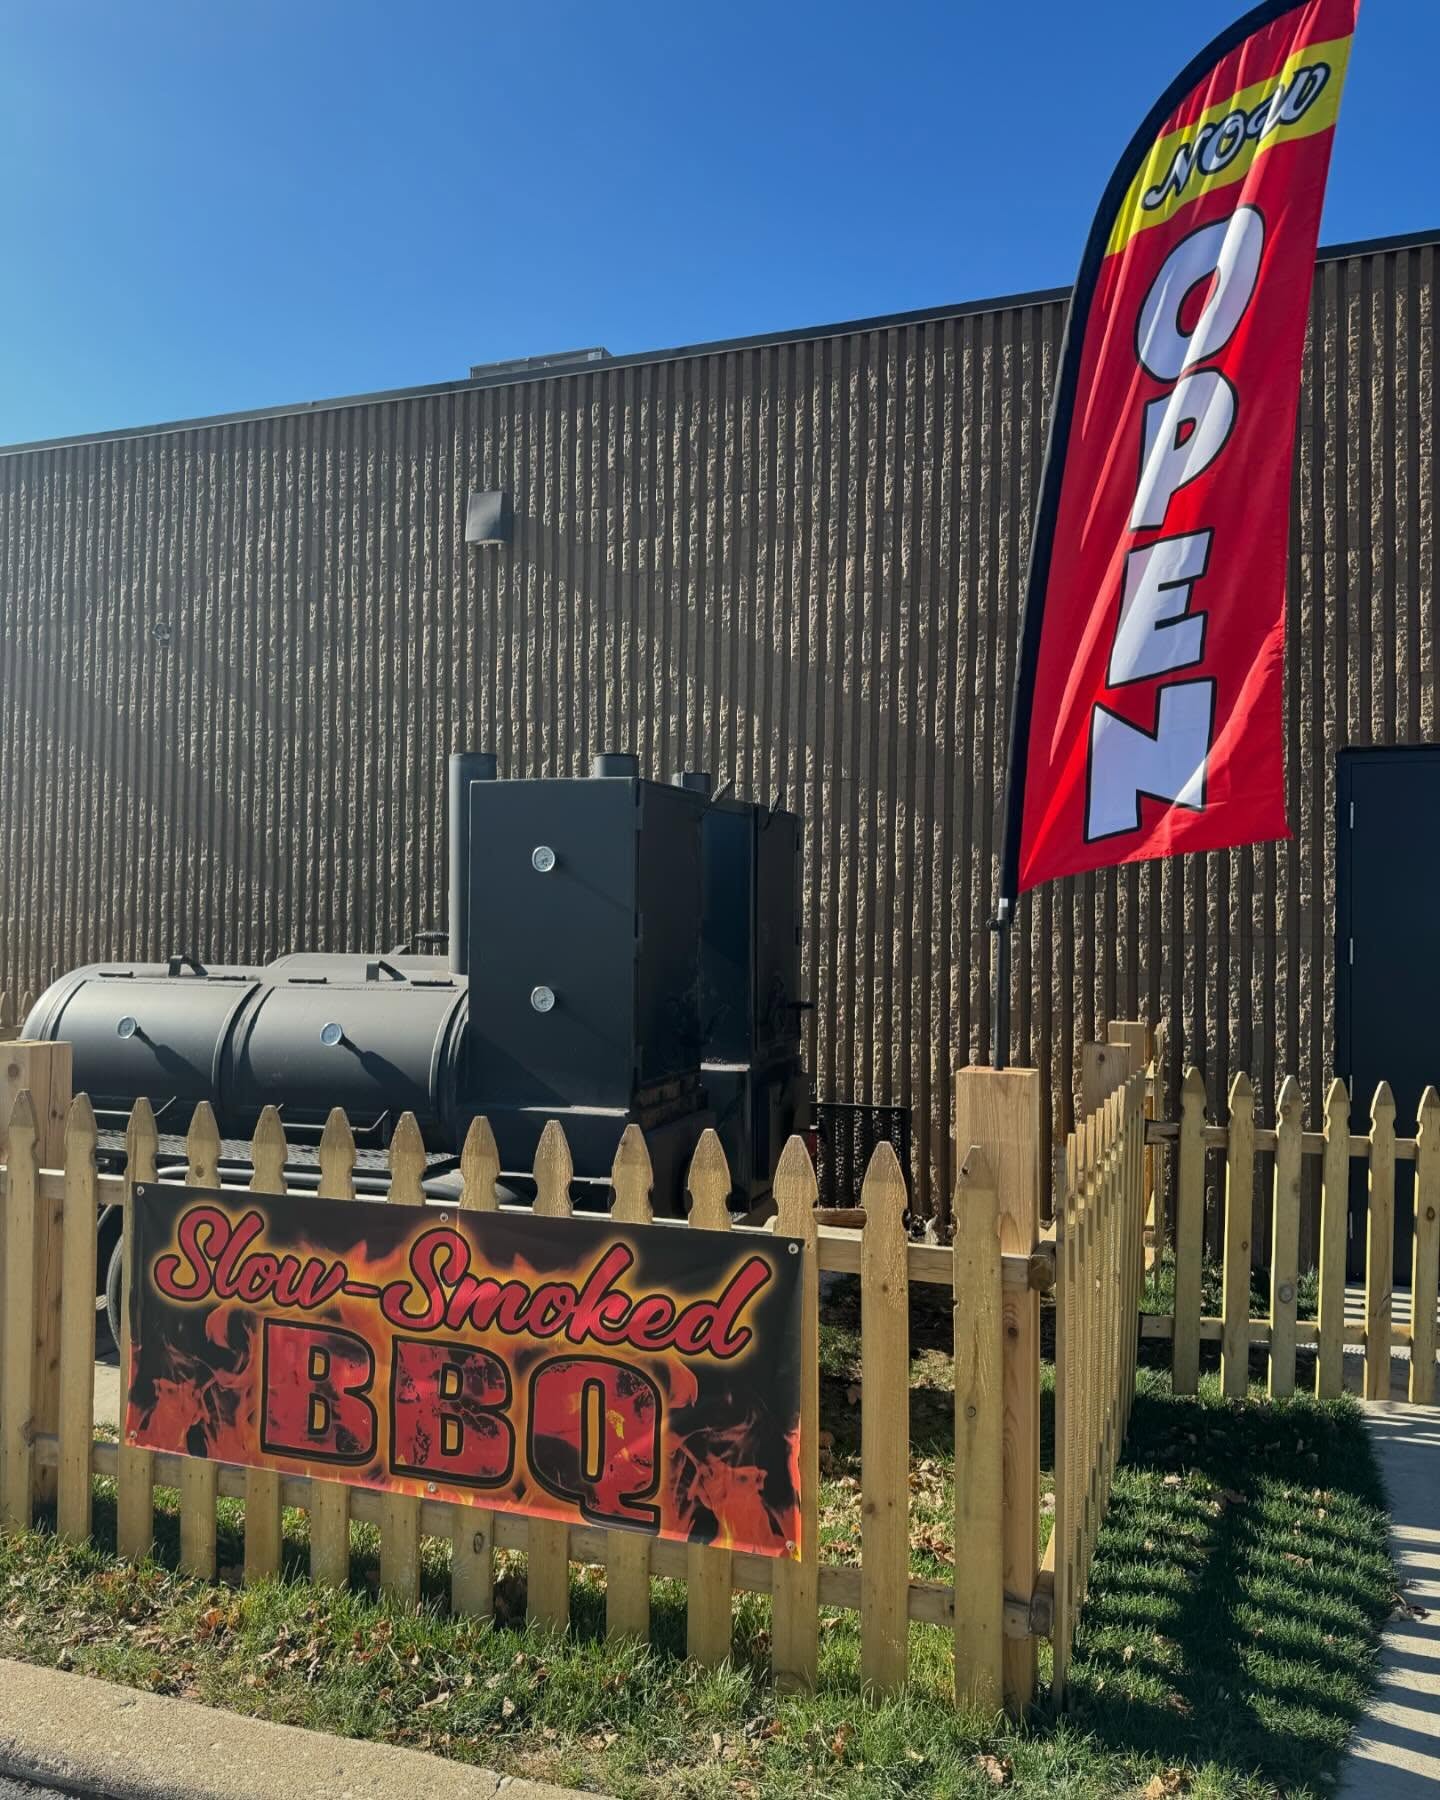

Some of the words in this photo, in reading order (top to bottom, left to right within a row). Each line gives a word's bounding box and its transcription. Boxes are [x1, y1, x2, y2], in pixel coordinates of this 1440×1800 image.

[1141, 62, 1331, 211] NOW
[1084, 204, 1265, 843] OPEN
[153, 1205, 772, 1359] Slow-Smoked
[259, 1317, 662, 1532] BBQ
